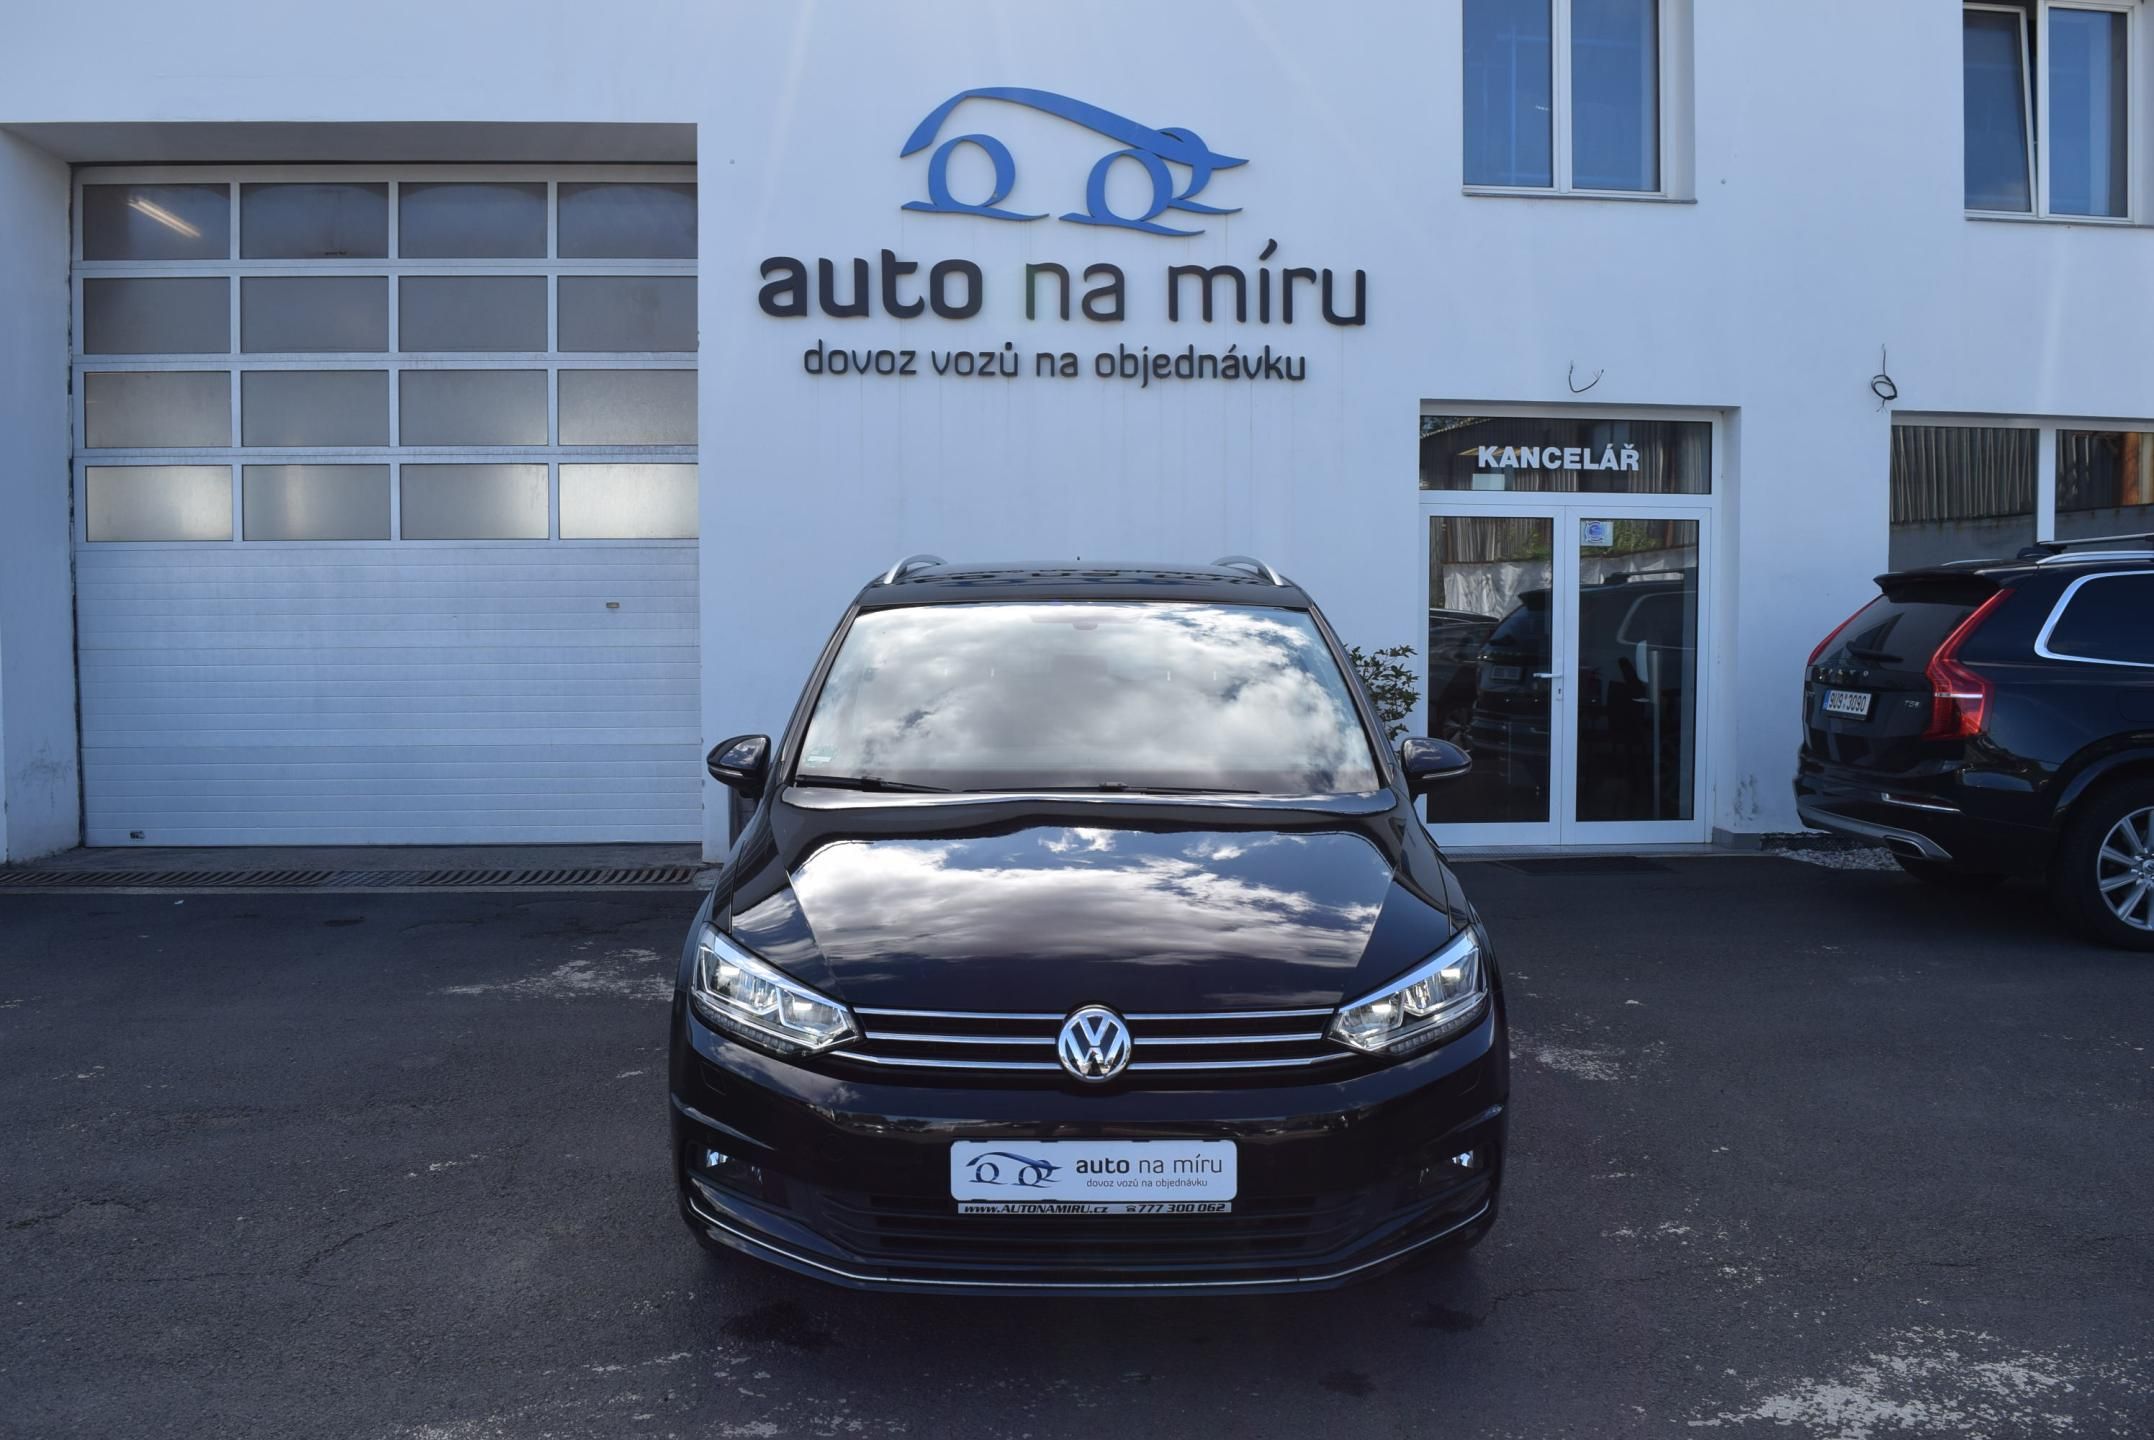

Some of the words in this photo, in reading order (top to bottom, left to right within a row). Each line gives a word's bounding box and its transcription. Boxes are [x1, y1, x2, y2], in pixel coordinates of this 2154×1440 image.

[758, 248, 983, 321] auto
[1025, 262, 1126, 323] na
[1167, 238, 1367, 327] míru
[803, 338, 917, 377] dovoz
[931, 341, 1019, 379] vozů
[1035, 352, 1079, 379] na
[1094, 343, 1306, 389] objednávku
[1477, 443, 1640, 471] KANCELÁŘ
[1076, 1157, 1130, 1174] auto
[1139, 1159, 1164, 1174] na
[1173, 1153, 1222, 1174] míru
[1086, 1178, 1114, 1188] dovoz
[1117, 1177, 1139, 1188] vozů
[1141, 1180, 1153, 1188] na
[1155, 1177, 1208, 1189] objednávku
[964, 1203, 1108, 1214] www.AUTONAMIRU.cz
[1138, 1204, 1164, 1213] 777
[1167, 1204, 1195, 1213] 300
[1197, 1203, 1226, 1212] 062
